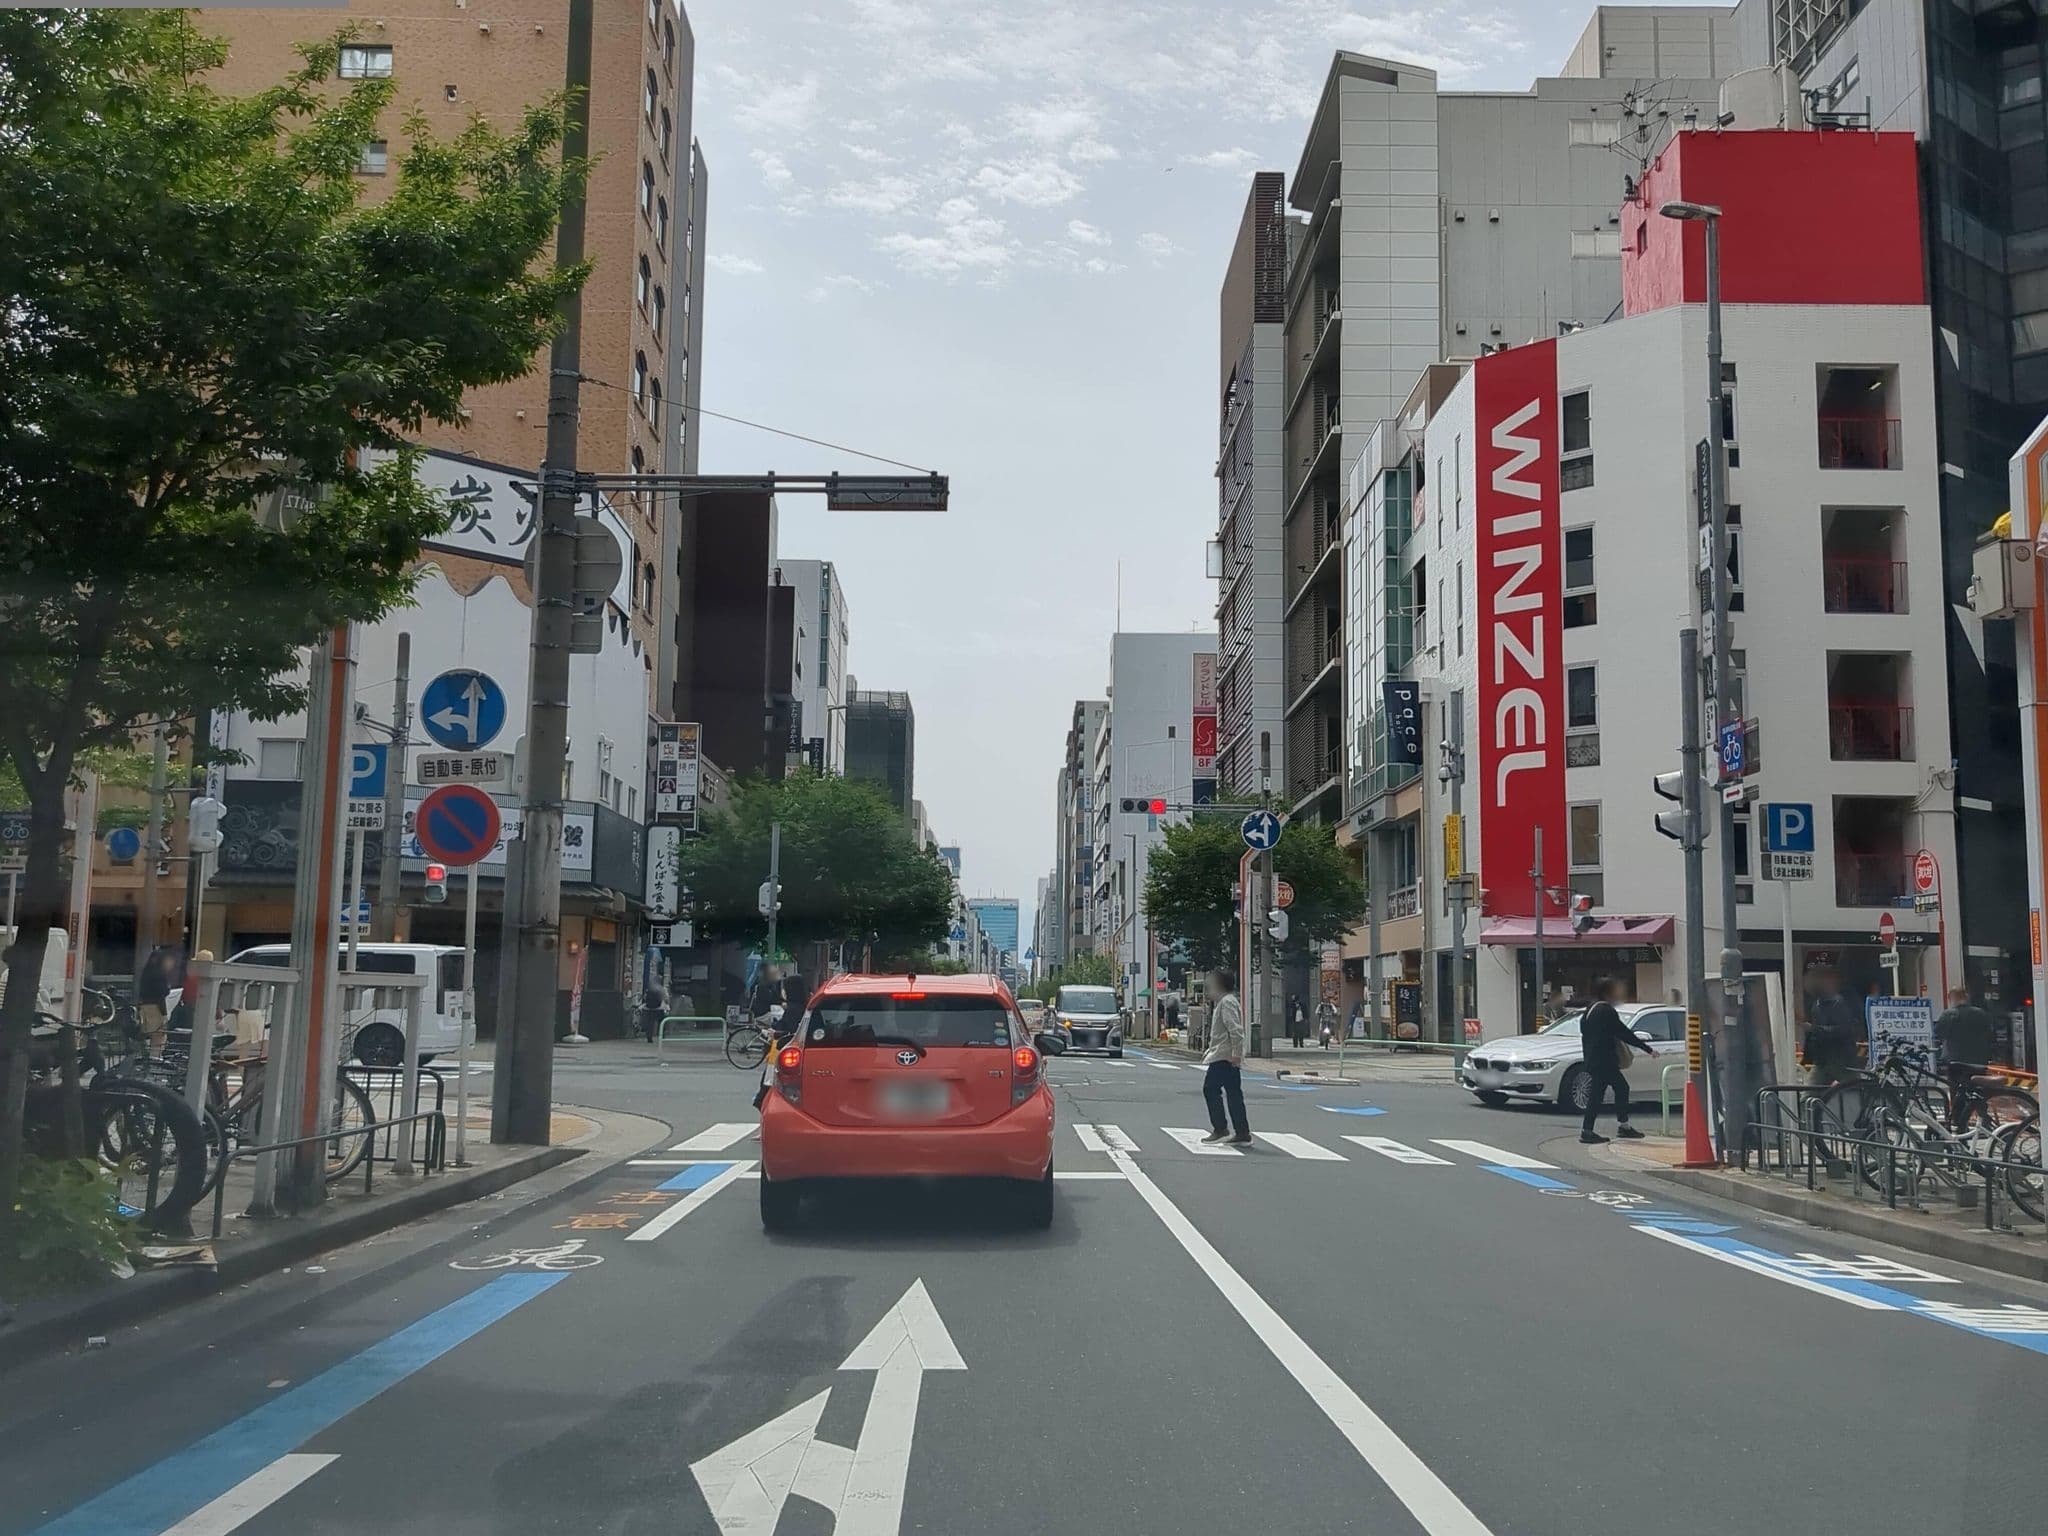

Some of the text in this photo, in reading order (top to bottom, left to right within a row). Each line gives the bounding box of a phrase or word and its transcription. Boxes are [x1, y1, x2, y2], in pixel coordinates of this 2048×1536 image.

[1492, 396, 1546, 808] WINZEL
[1395, 690, 1417, 753] pace
[423, 758, 497, 779] 自動車・原付
[1198, 757, 1211, 768] 8F
[1780, 808, 1806, 847] P
